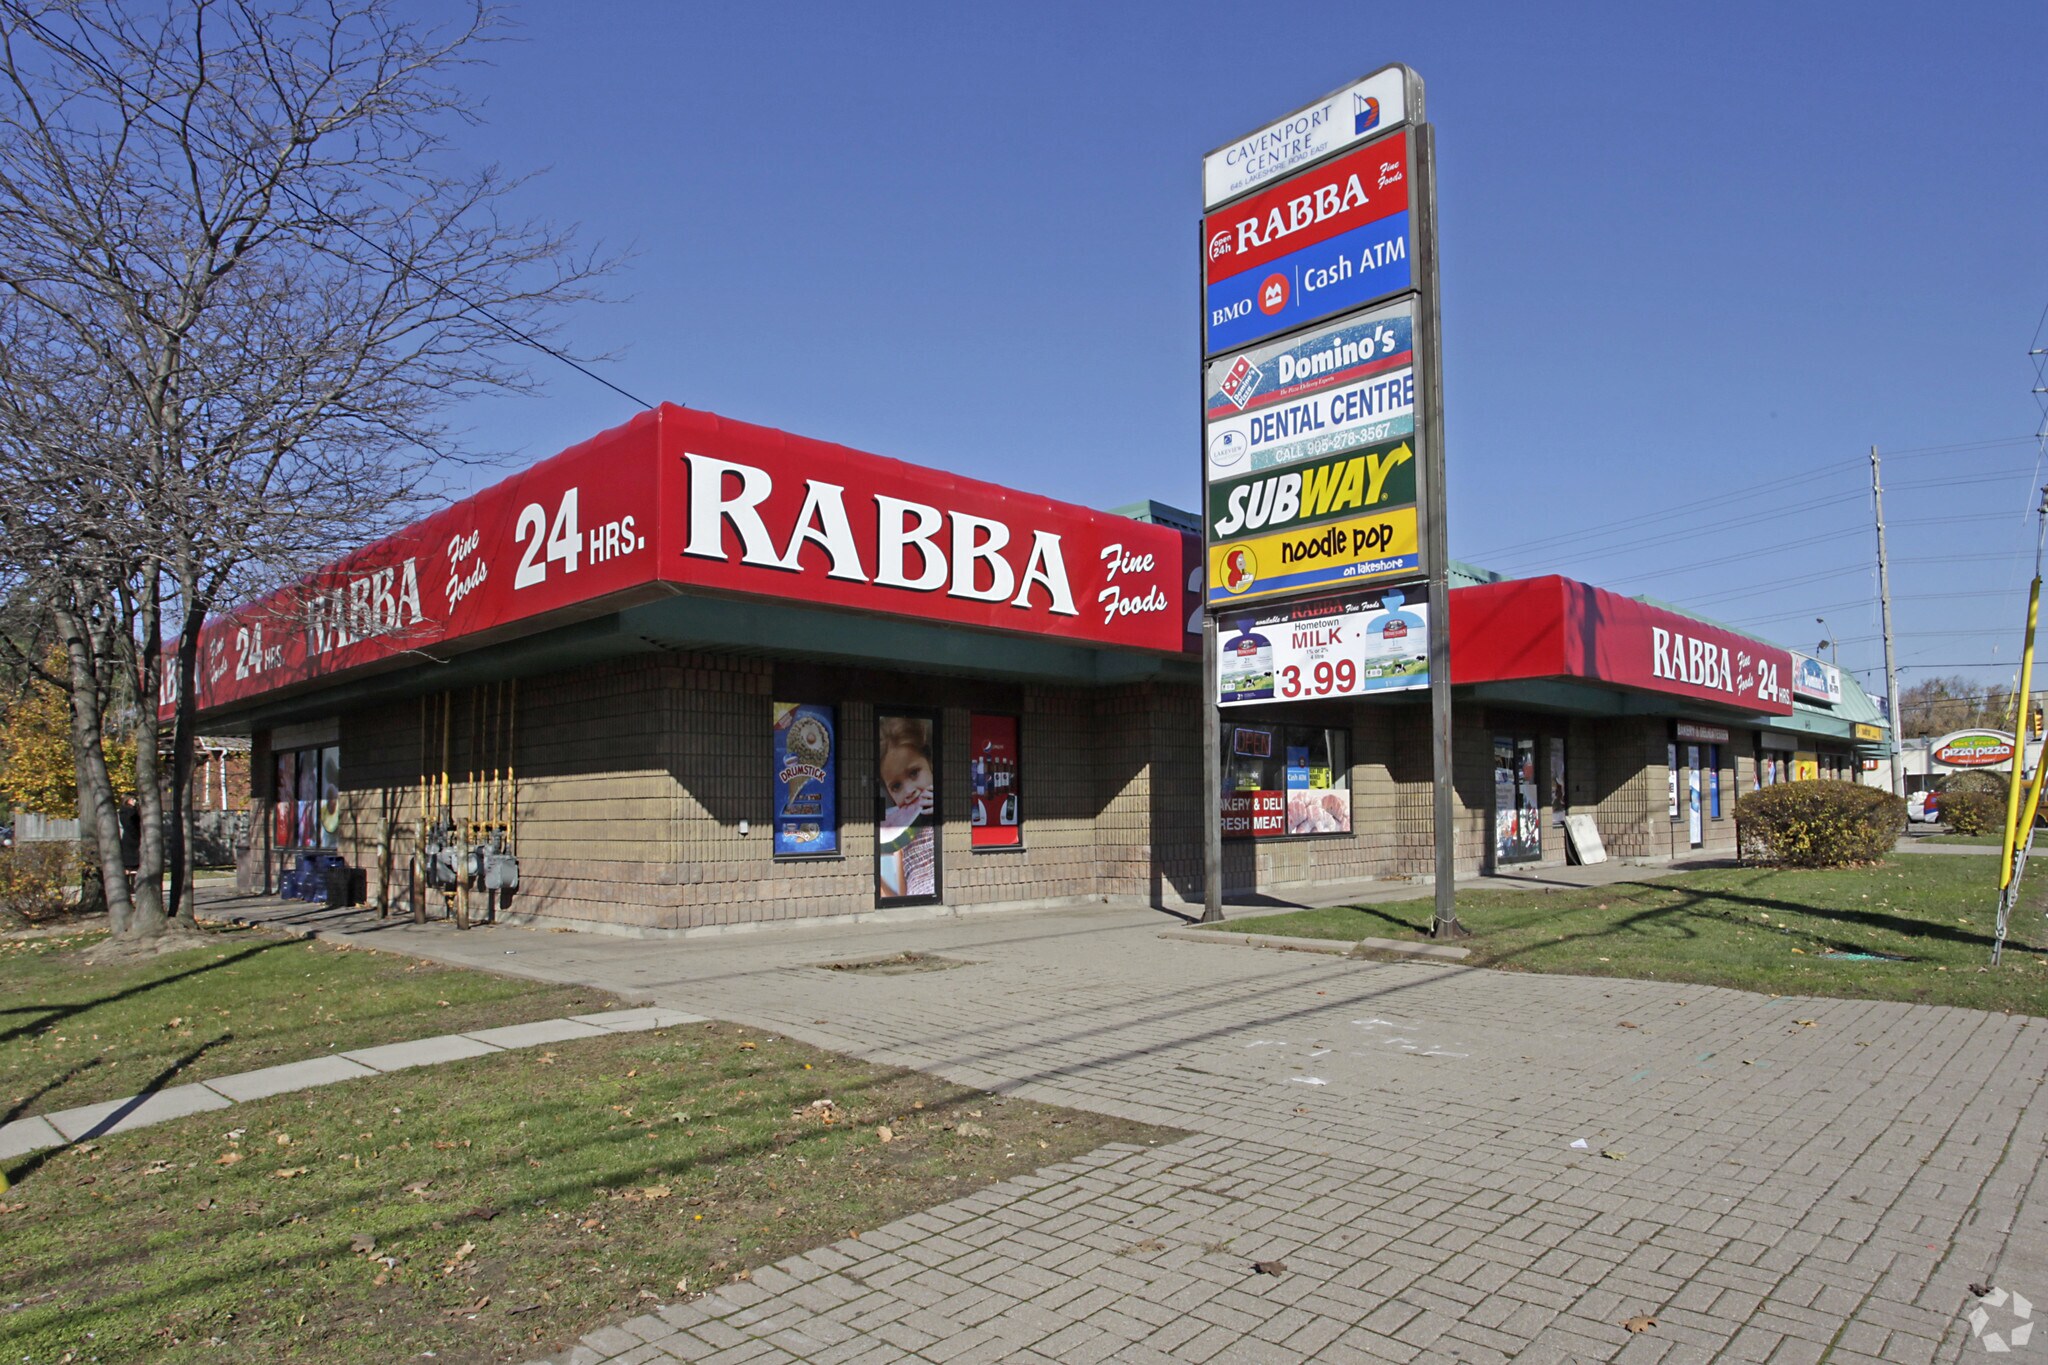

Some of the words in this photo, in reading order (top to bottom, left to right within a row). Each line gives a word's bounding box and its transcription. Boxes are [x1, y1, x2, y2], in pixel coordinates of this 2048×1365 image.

[1226, 105, 1332, 166] CAVENPORT
[1246, 133, 1312, 175] CENTRE
[1245, 161, 1285, 185] LAKESHORE
[1288, 152, 1308, 166] ROAD
[1310, 142, 1328, 155] EAST
[1378, 171, 1402, 190] Foods
[1380, 161, 1400, 176] Fine
[1235, 173, 1369, 255] RABBA
[1213, 234, 1232, 247] open
[1213, 243, 1232, 258] 24h
[1212, 298, 1252, 327] BMO
[1304, 254, 1352, 292] Cash
[1359, 236, 1406, 274] ATM
[1279, 325, 1396, 385] Domino's
[1234, 369, 1256, 400] Domino's
[1239, 386, 1252, 405] Pizza
[1250, 400, 1325, 446] DENTAL
[1330, 373, 1414, 425] CENTRE
[1276, 449, 1304, 463] CALL
[1217, 446, 1409, 536] SUBWAY
[447, 529, 479, 575] Fine
[514, 486, 582, 590] 24
[590, 515, 645, 565] HRS.
[683, 452, 1079, 616] RABBA
[1281, 526, 1348, 564] noodle
[1353, 523, 1394, 557] pop
[1099, 543, 1155, 582] Fine
[1343, 566, 1356, 577] on
[1357, 558, 1403, 575] lakeshore
[445, 558, 488, 616] Foods
[1097, 585, 1168, 625] Foods
[1295, 619, 1339, 631] Hometown
[1345, 603, 1360, 614] Fine
[1361, 601, 1380, 612] Foods
[236, 622, 262, 681] 24
[1292, 627, 1343, 649] MILK
[1281, 658, 1357, 698] 3.99
[1652, 626, 1733, 693] RABBA
[1737, 651, 1751, 672] Fine
[1736, 672, 1754, 697] Foods
[1758, 659, 1778, 702] 24
[1237, 731, 1269, 754] OPEN
[1942, 748, 1974, 760] pizza
[1976, 746, 2010, 758] pizza
[780, 765, 826, 783] DRUMSTICK
[1220, 798, 1250, 811] AKERY
[1253, 797, 1260, 811] &
[1263, 797, 1283, 811] DELI
[1220, 817, 1249, 830] RESH
[1253, 816, 1283, 830] MEAT
